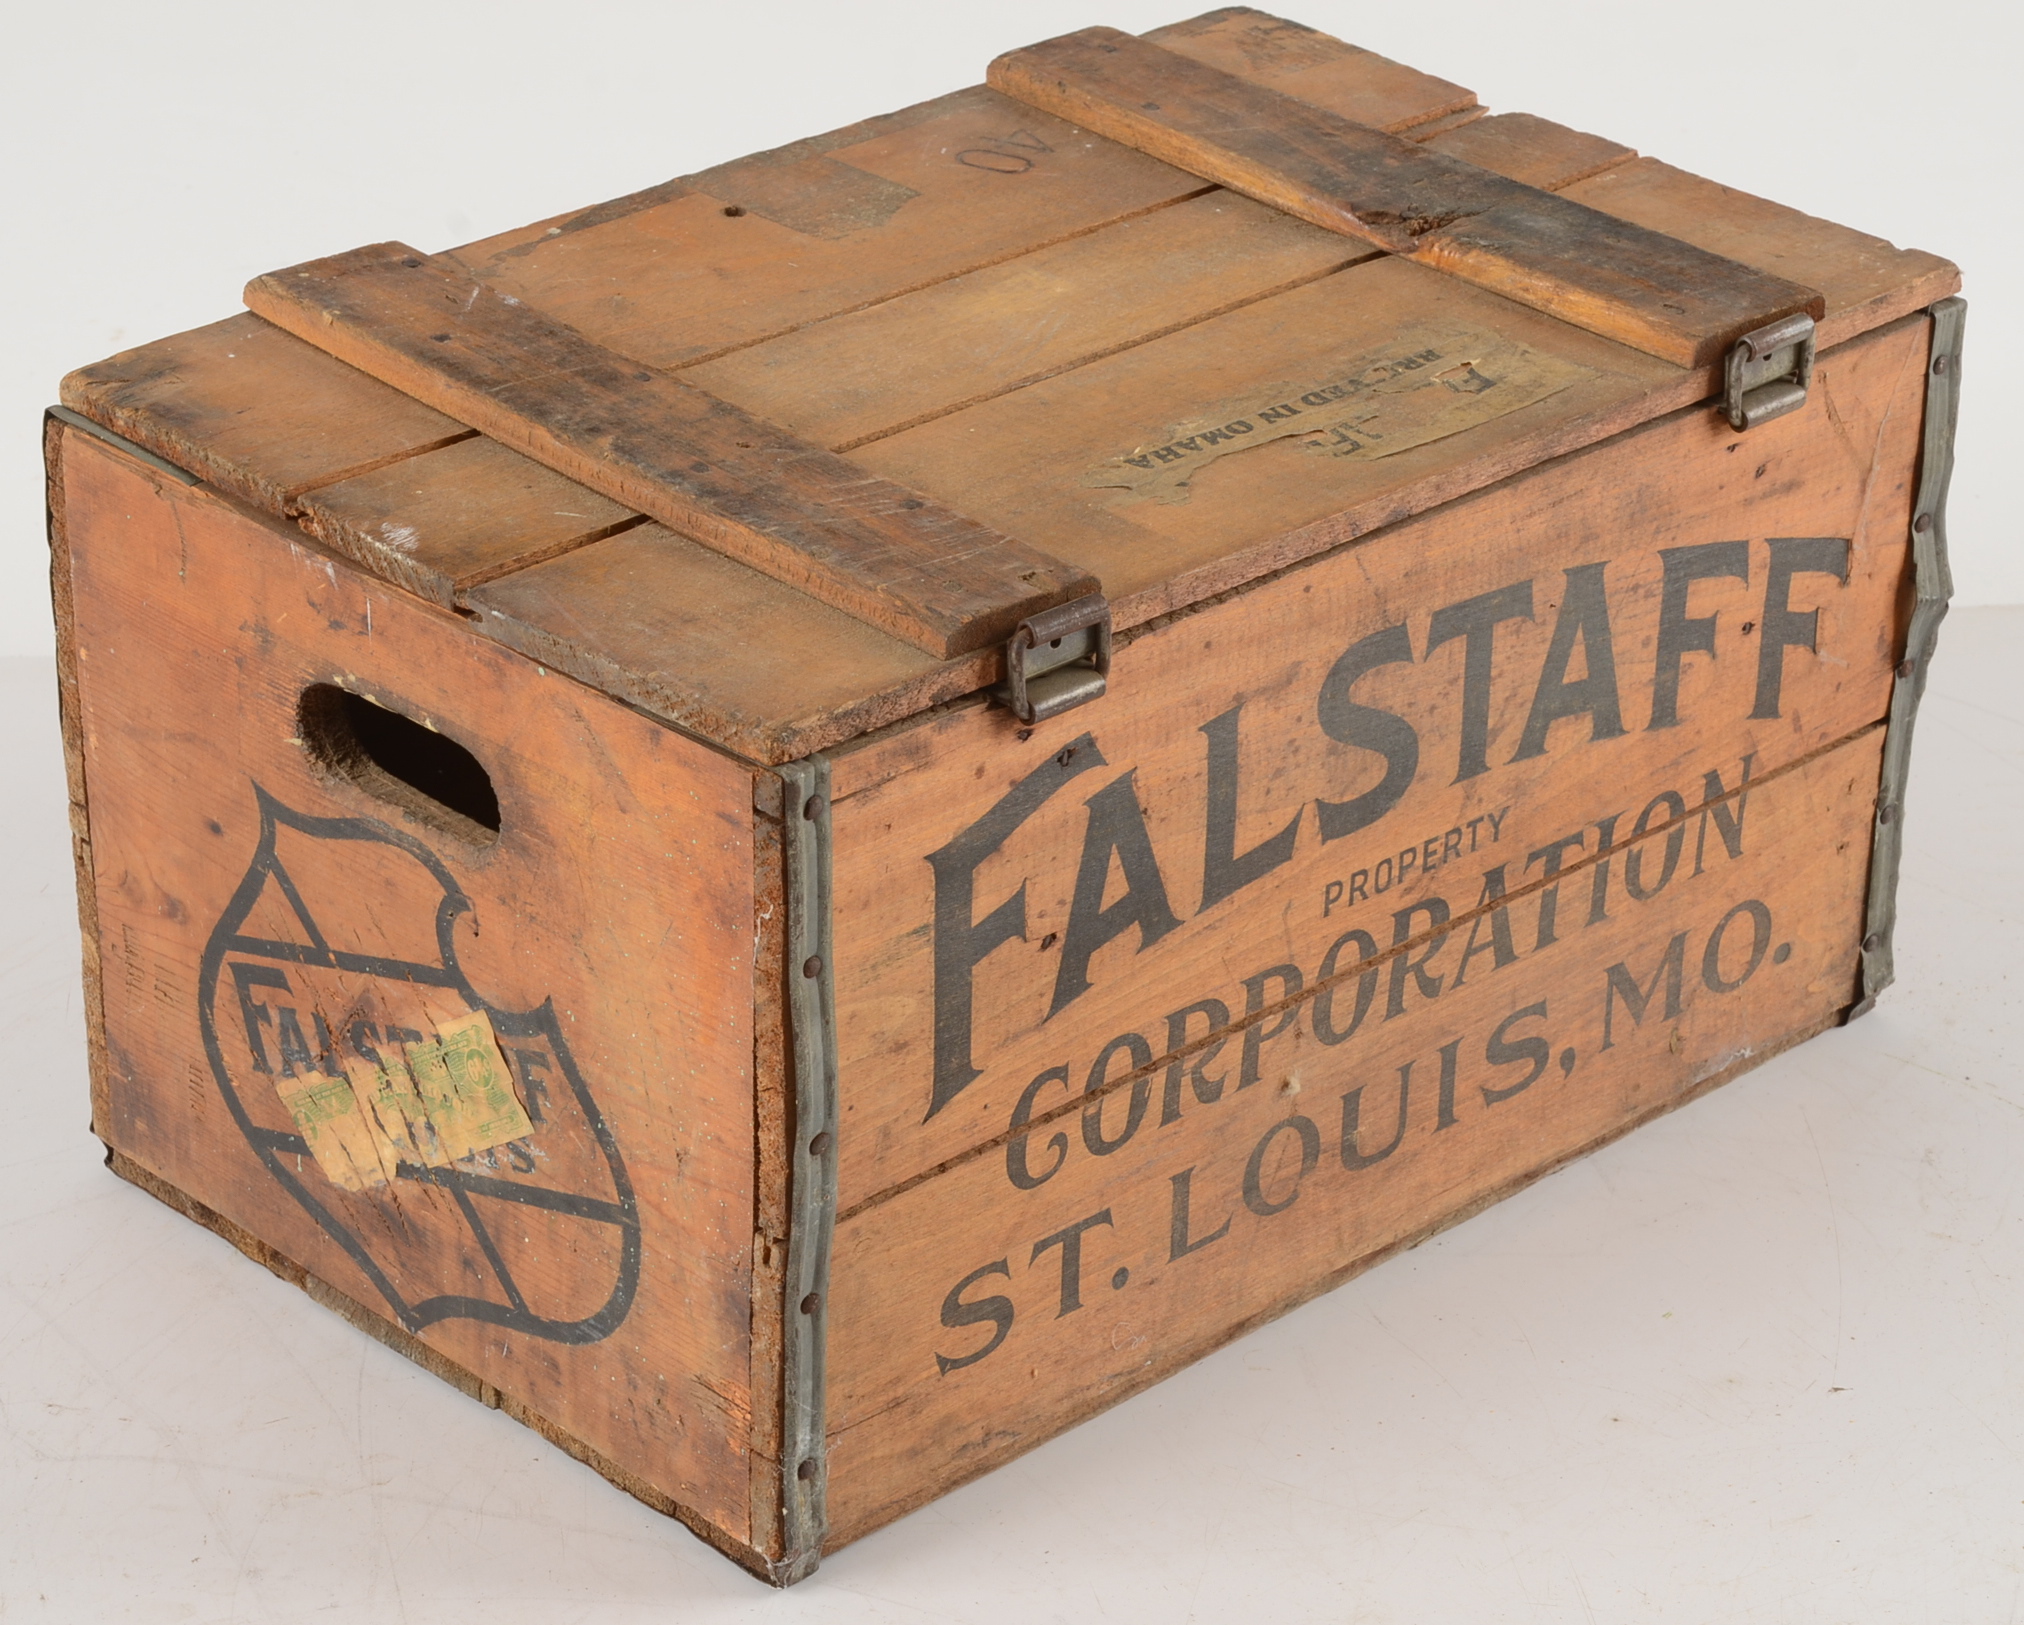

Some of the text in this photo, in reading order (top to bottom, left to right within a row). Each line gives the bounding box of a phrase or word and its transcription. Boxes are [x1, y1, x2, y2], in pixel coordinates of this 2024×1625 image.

[1122, 418, 1256, 470] OMAHA
[1256, 398, 1304, 427] IN
[921, 536, 1852, 1127] FALSTAFF
[1322, 805, 1511, 918] PROPERTY
[227, 961, 553, 1125] FALSF
[1005, 750, 1759, 1191] CORPORATION
[933, 898, 1792, 1378] ST. LOUIS, MO.
